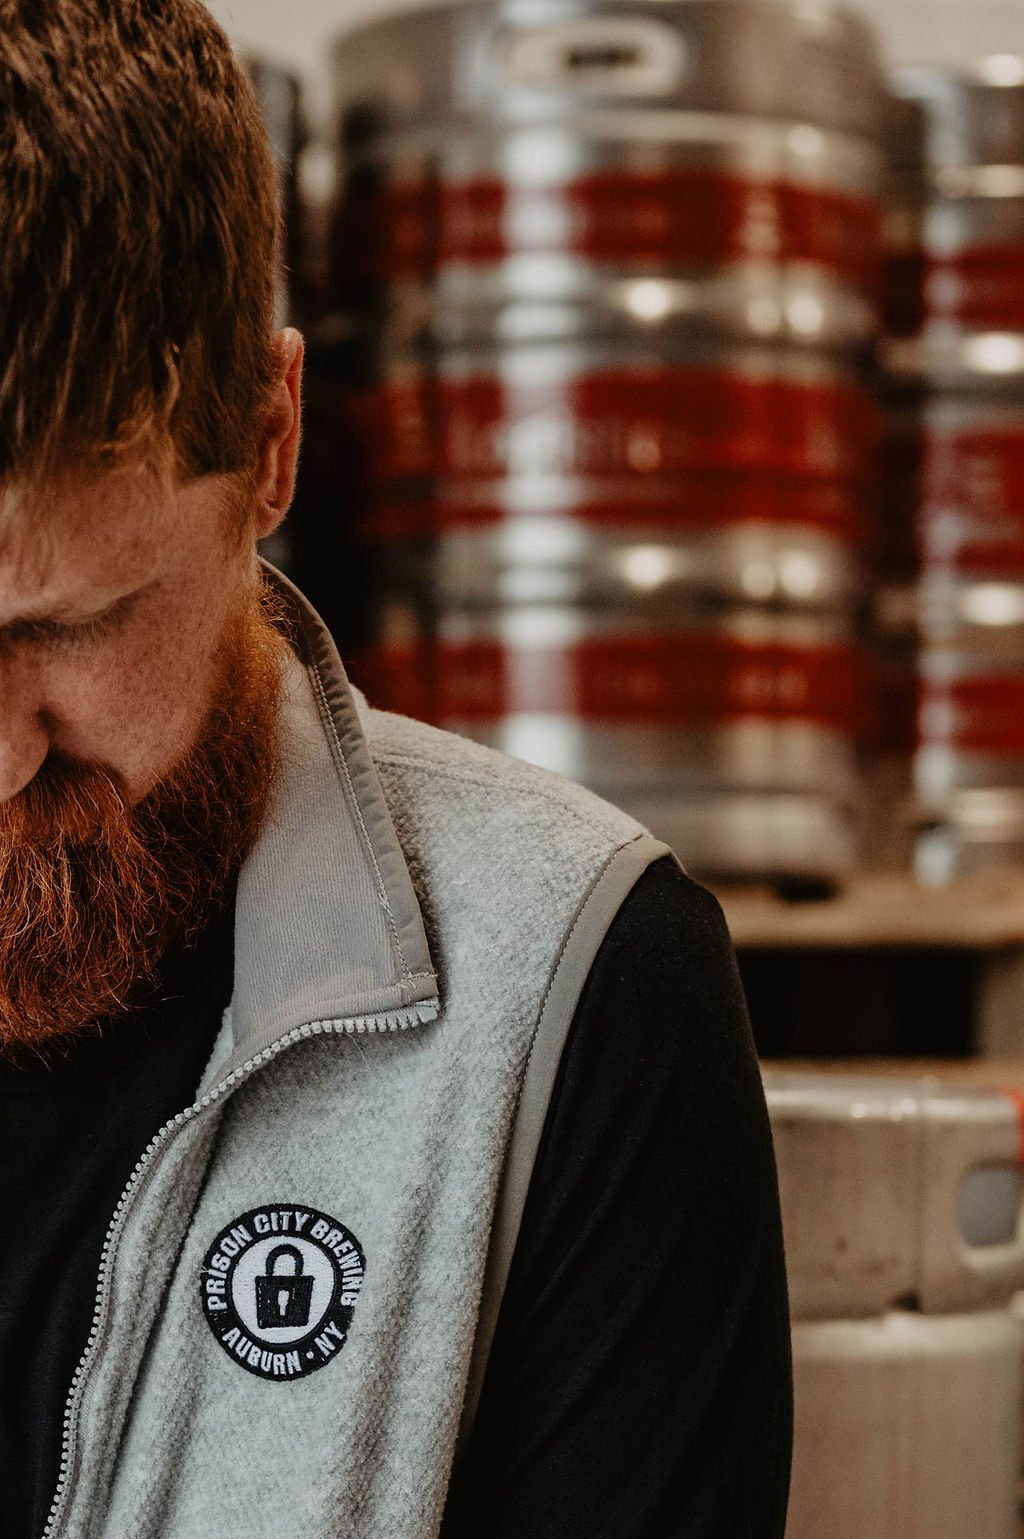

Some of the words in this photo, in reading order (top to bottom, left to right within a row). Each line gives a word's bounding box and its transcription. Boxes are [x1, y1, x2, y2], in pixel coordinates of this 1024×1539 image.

[205, 1224, 253, 1311] PRISON
[253, 1211, 310, 1234] CITY
[310, 1218, 364, 1307] BREWING
[222, 1327, 302, 1375] AUBURN
[314, 1320, 345, 1356] NY
